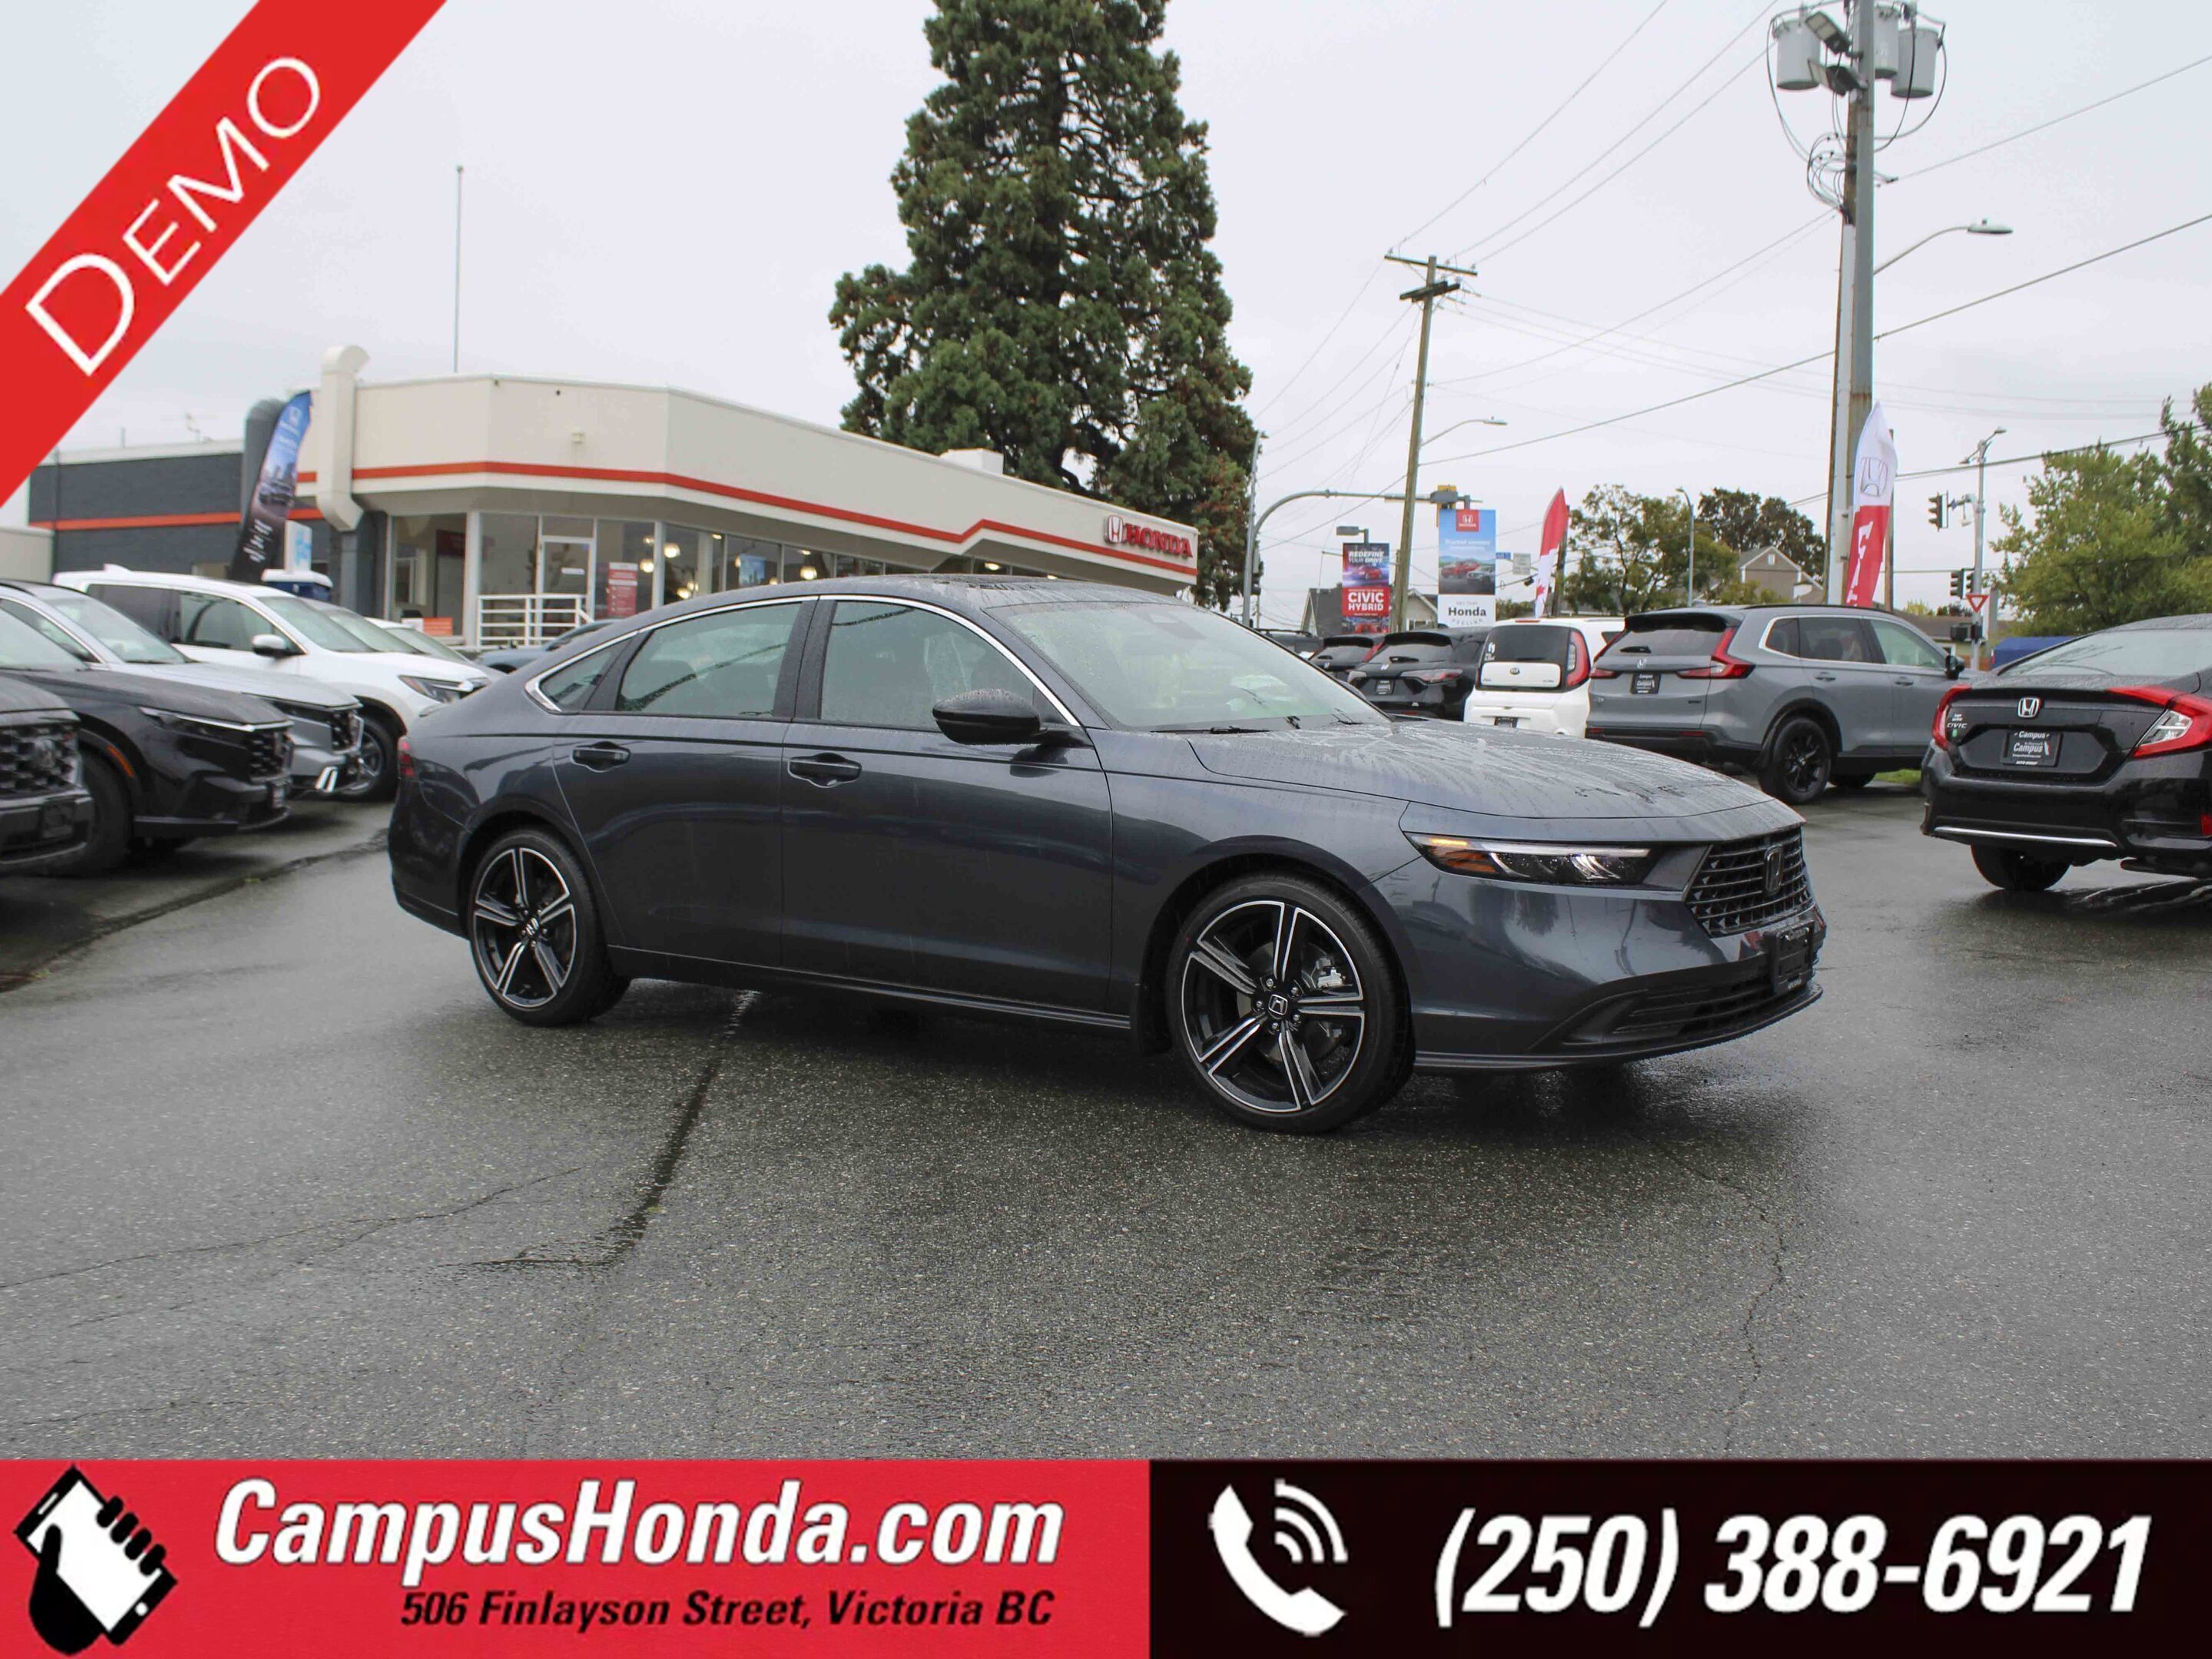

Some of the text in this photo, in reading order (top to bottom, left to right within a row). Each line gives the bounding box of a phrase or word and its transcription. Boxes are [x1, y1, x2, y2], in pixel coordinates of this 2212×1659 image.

[1124, 523, 1193, 558] HONDA
[1348, 592, 1384, 603] CIVIC
[1348, 603, 1384, 611] HYBRID
[1448, 607, 1487, 617] Honda
[2018, 730, 2046, 740] Campus
[2013, 743, 2043, 753] Campus
